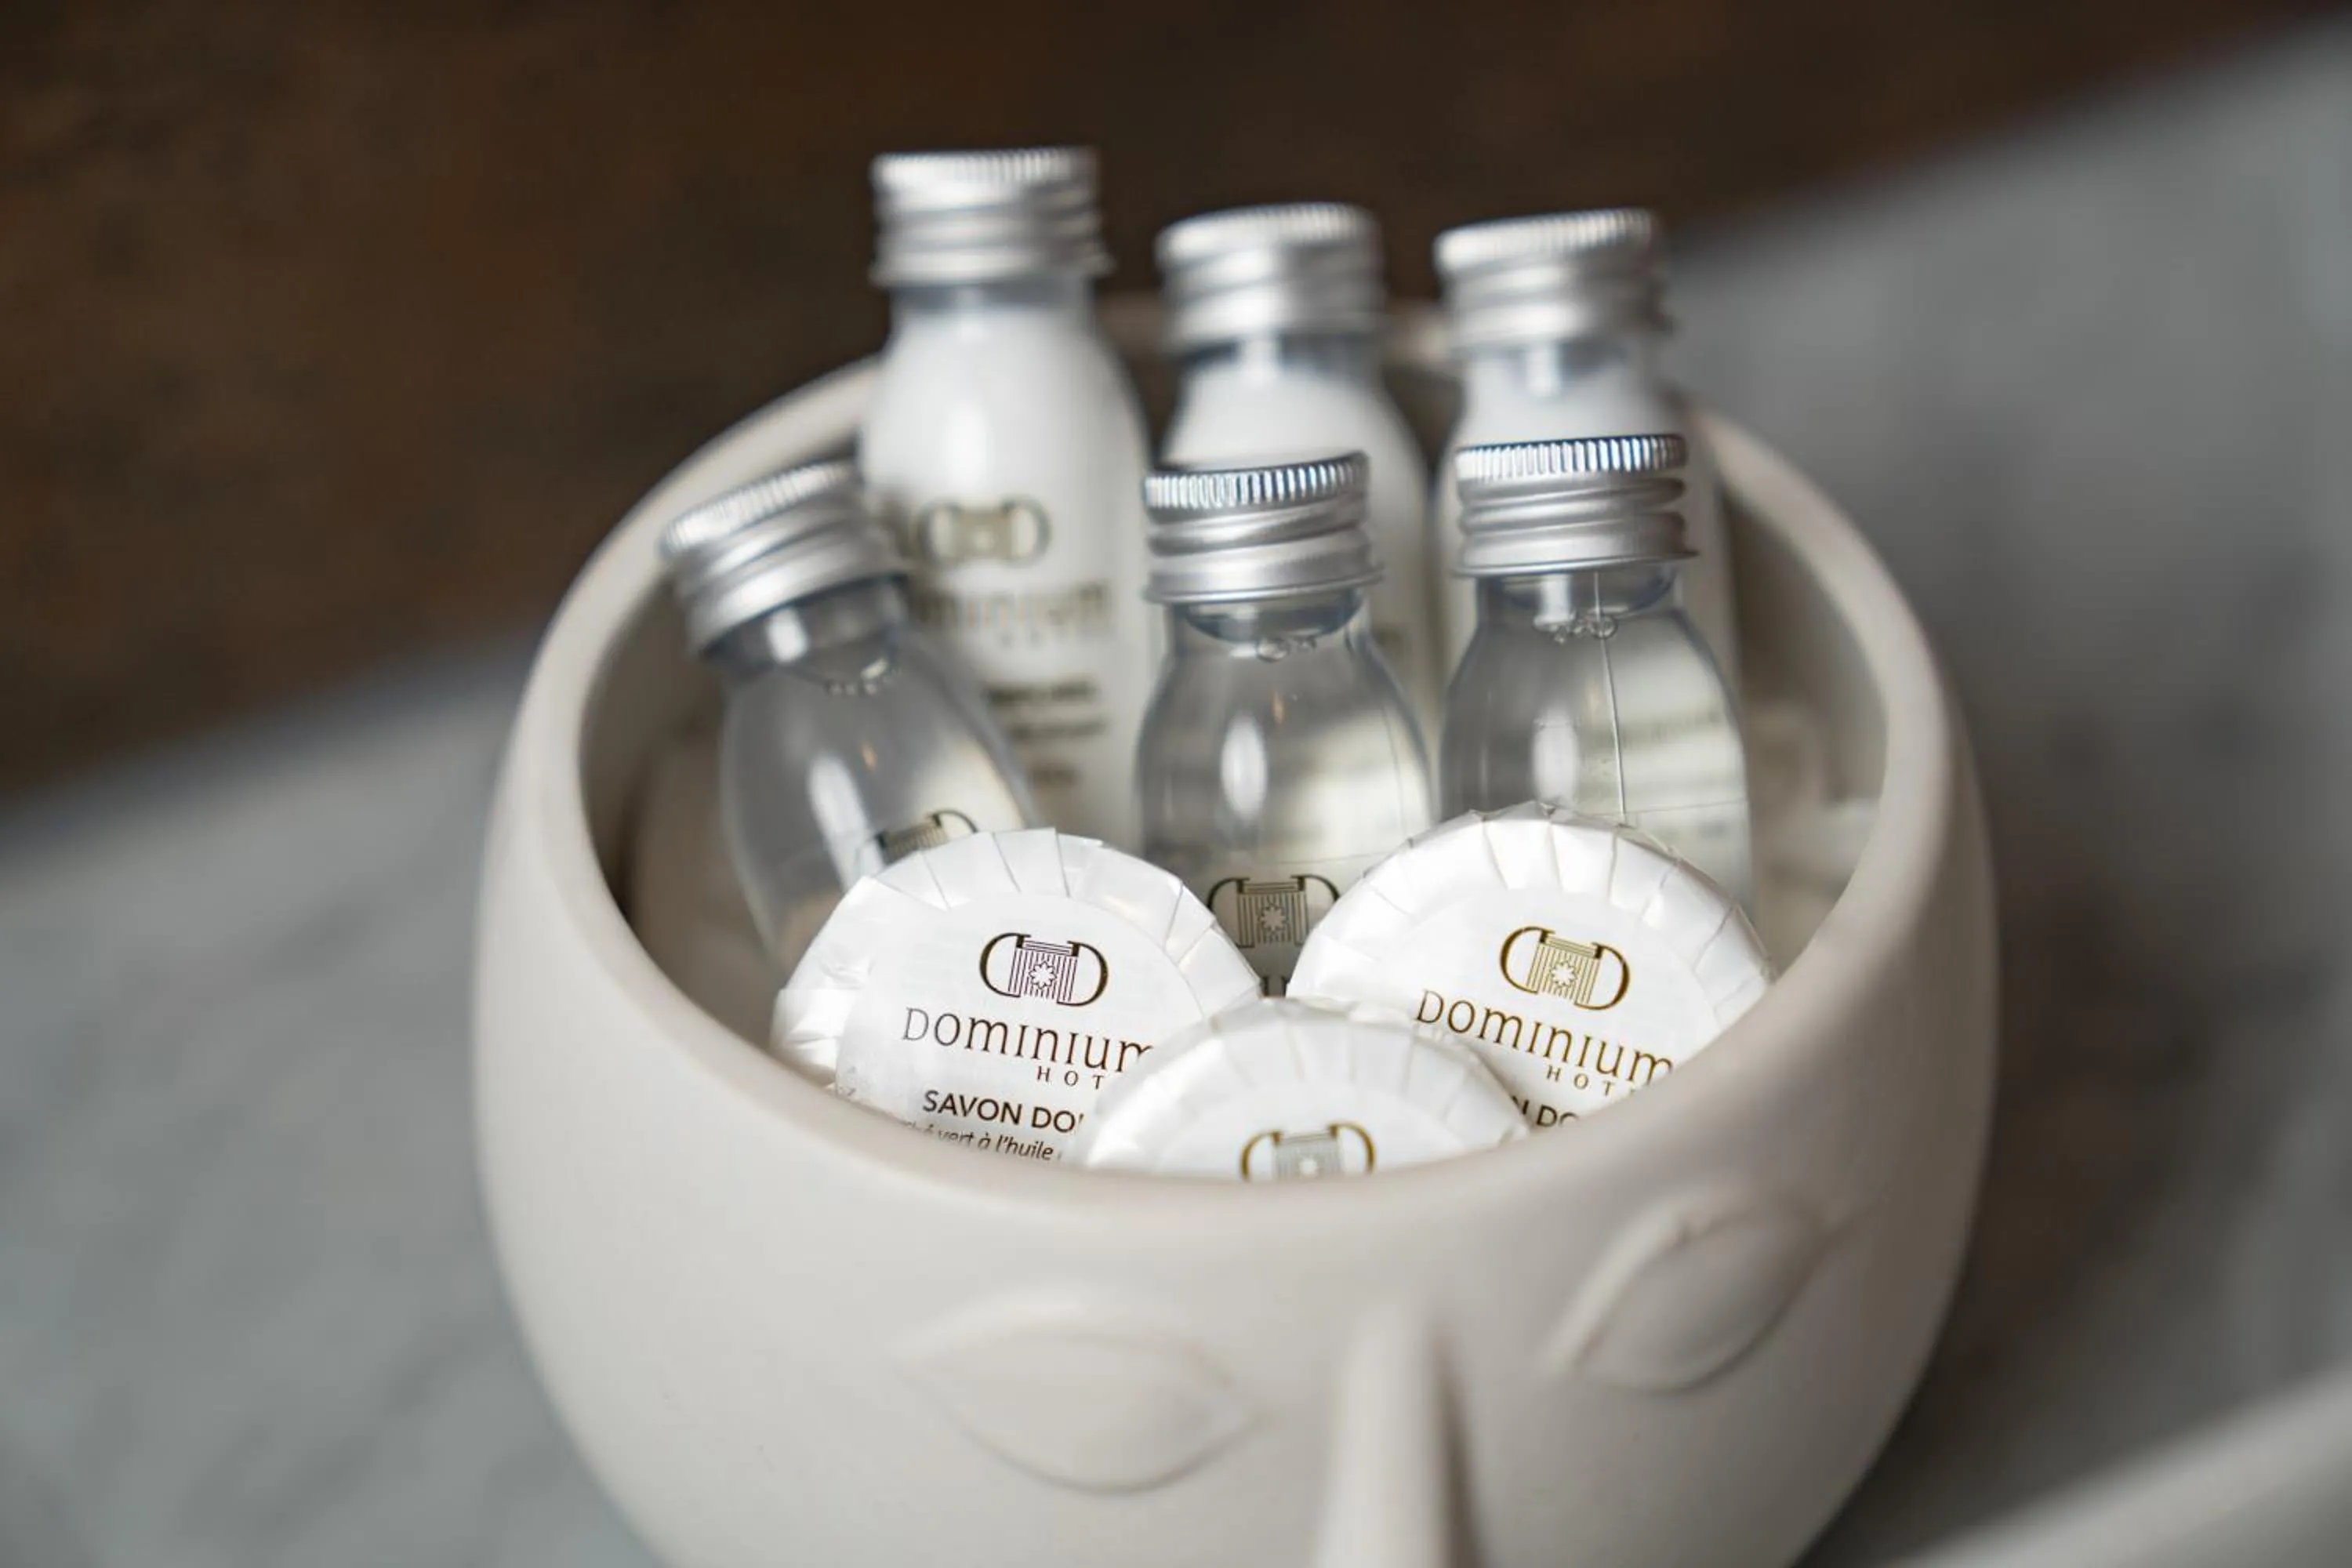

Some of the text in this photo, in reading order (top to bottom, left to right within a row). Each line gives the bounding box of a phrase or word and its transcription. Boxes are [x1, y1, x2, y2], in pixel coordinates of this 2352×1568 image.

[1036, 1065, 1105, 1090] HOT
[1546, 1065, 1635, 1096] HOT
[923, 1089, 1084, 1134] SAVON DO
[996, 1134, 1054, 1161] l'huile
